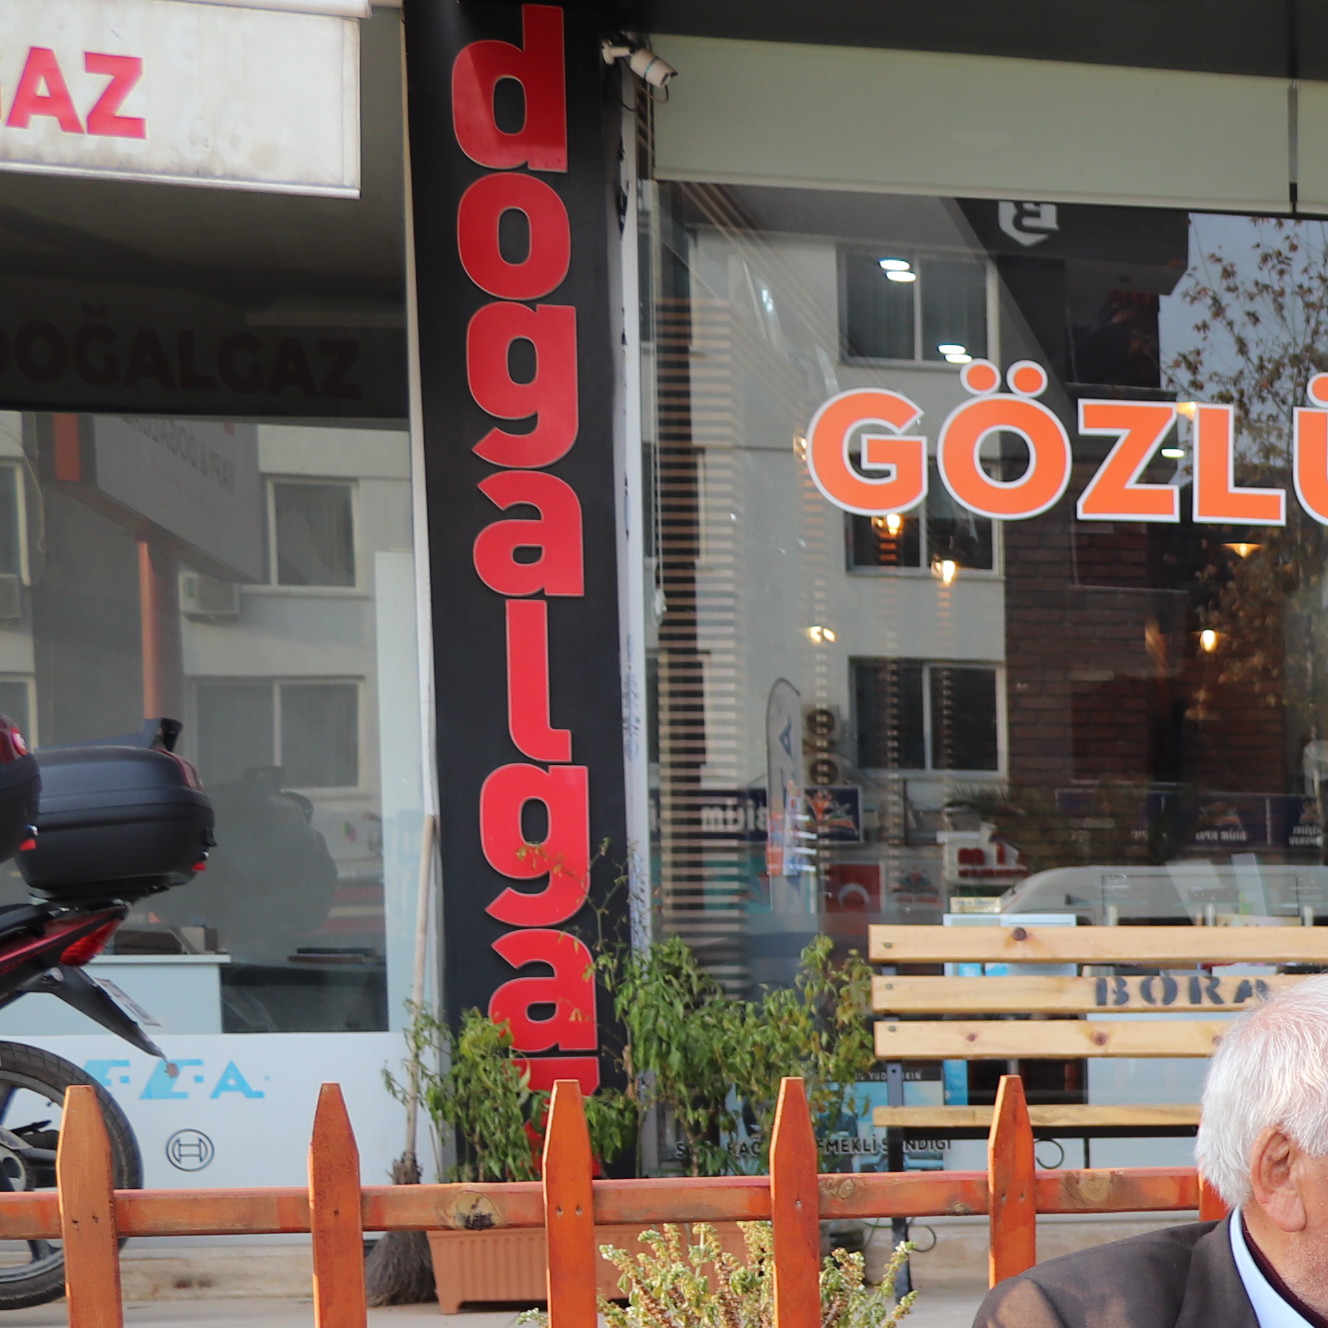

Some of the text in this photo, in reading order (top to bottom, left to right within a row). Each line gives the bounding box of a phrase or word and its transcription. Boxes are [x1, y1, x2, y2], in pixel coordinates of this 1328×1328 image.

[0, 45, 148, 140] AZ
[0, 302, 363, 401] OĞALGAZ
[1095, 976, 1270, 1007] BORA
